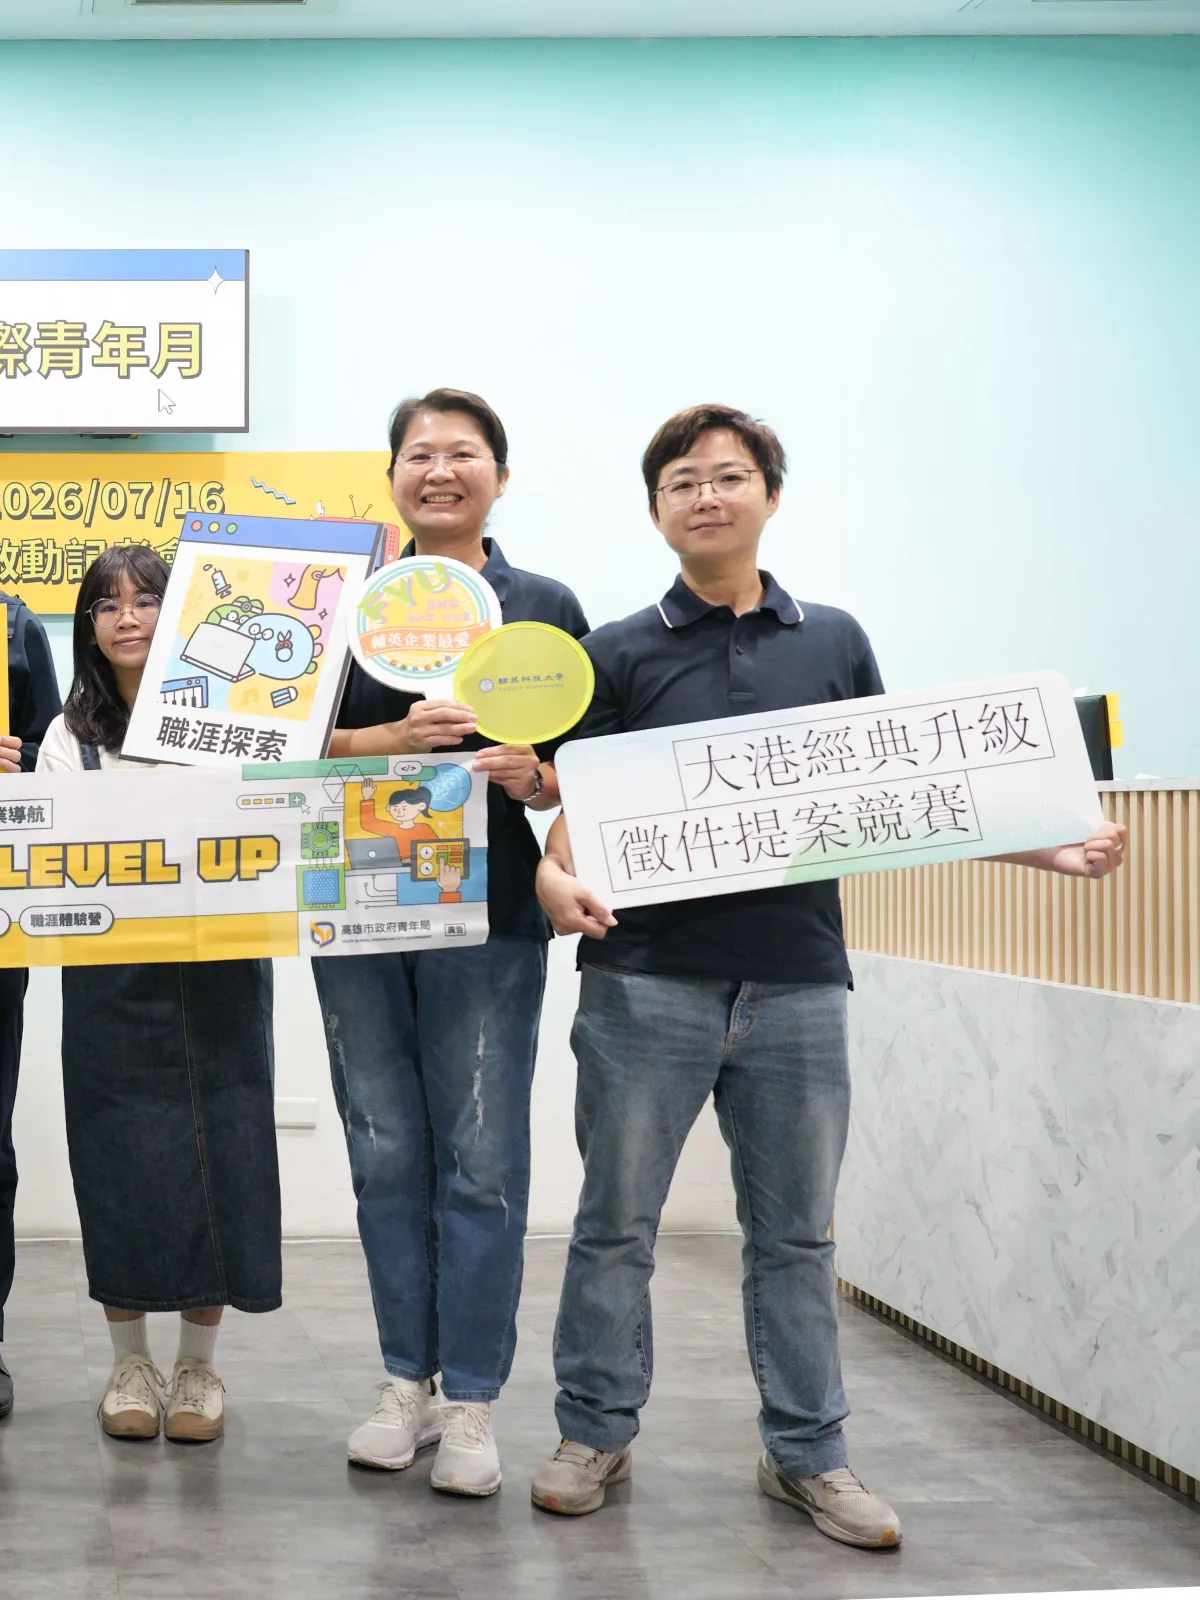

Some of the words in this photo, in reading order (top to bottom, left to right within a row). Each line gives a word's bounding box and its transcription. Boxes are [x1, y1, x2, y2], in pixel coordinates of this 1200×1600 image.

[156, 716, 288, 762] 職涯探索
[684, 701, 1040, 800] 大港經典升級
[612, 782, 969, 881] 徵件提案競賽
[197, 834, 280, 883] UP
[30, 912, 102, 927] 職涯體驗營
[341, 920, 431, 936] 高雄市政府青年局
